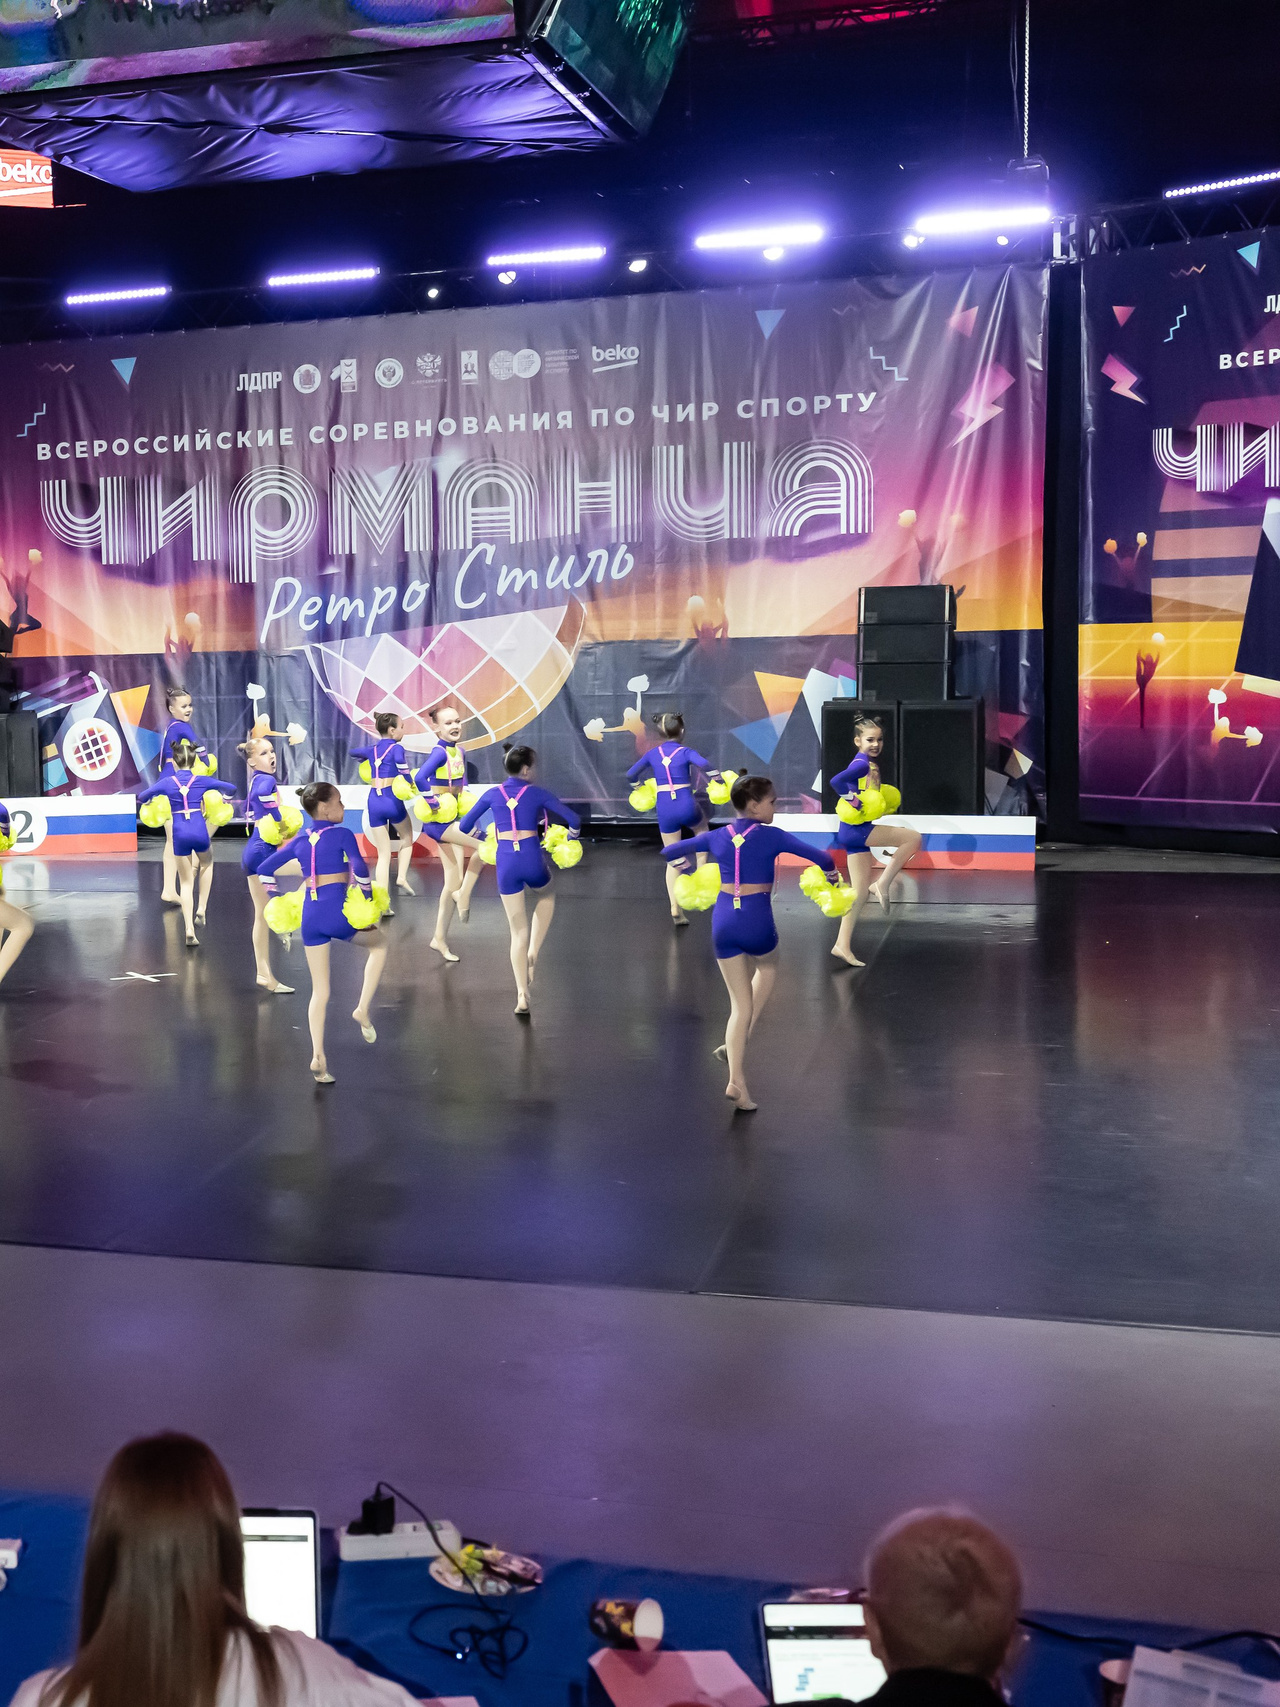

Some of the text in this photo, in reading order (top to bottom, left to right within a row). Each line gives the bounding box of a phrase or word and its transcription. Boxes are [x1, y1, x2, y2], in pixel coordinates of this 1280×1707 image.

[592, 344, 640, 362] beko
[236, 371, 282, 393] ЛДПР
[36, 391, 878, 461] ВСЕРОССИЙСКИЕ СОРЕВНОВАНИЯ ПО ЧИР СПОРТУ
[260, 542, 635, 643] Ретро Стиль
[10, 811, 34, 843] 2
